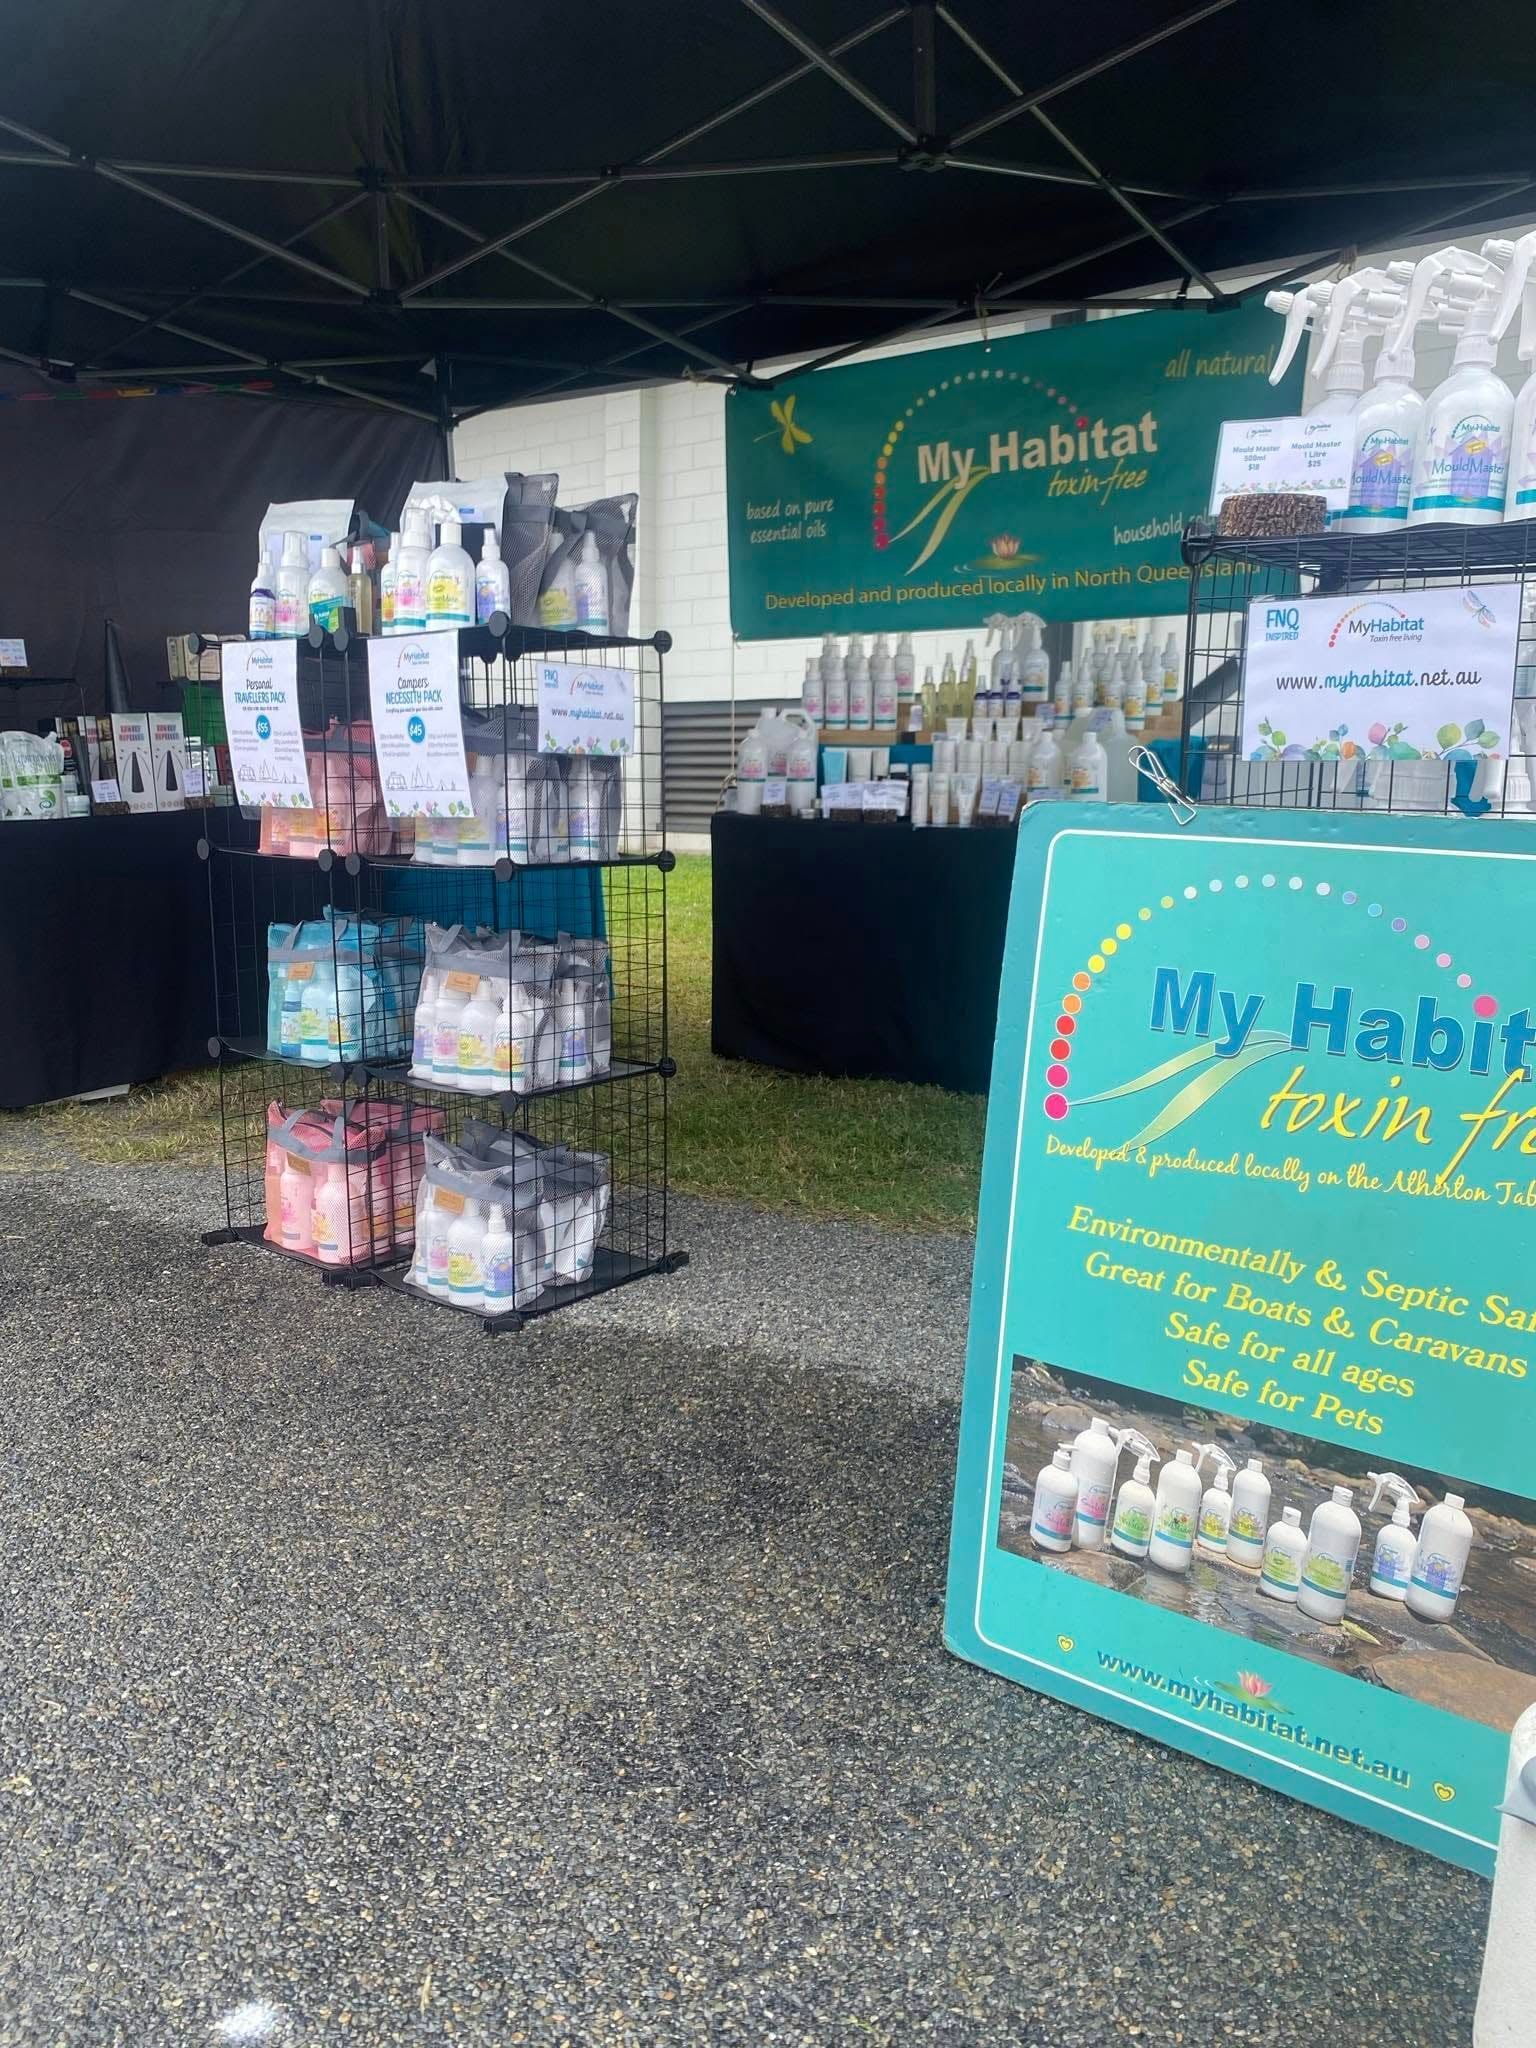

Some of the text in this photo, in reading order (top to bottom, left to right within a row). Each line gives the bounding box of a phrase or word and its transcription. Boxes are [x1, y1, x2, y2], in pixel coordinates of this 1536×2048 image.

[1165, 344, 1275, 378] all natural
[917, 411, 1158, 490] My Habitat
[1307, 460, 1322, 468] $25
[1048, 458, 1148, 506] toxin-free
[746, 499, 834, 521] based on pure
[750, 519, 827, 544] essential oils
[1114, 511, 1183, 546] household
[765, 587, 854, 610] Developed
[858, 586, 892, 604] and
[896, 577, 984, 604] produced
[988, 573, 1047, 596] locally
[1052, 572, 1069, 590] in
[1075, 566, 1132, 587] North
[1266, 608, 1299, 631] FNQ
[1348, 616, 1425, 637] MyHabitat
[1265, 632, 1299, 642] INSPIRED
[1388, 634, 1402, 643] free
[1403, 632, 1423, 643] living
[246, 678, 273, 691] Personal
[398, 677, 430, 692] Campers
[1276, 668, 1482, 694] www.myhabitat.net.au
[234, 691, 287, 704] TRAVELLERS PACK
[424, 690, 443, 703] PACK
[409, 725, 423, 737] $45
[1150, 966, 1536, 1081] My Habit
[1260, 1065, 1433, 1146] toxin
[1046, 1134, 1131, 1171] Developed
[1135, 1146, 1148, 1164] &
[1149, 1148, 1240, 1178] produced
[1244, 1152, 1311, 1193] locally
[1318, 1171, 1342, 1185] on
[1347, 1162, 1382, 1190] the
[1384, 1168, 1492, 1201] Atherton
[1066, 1205, 1306, 1284] Environmentally
[1314, 1258, 1347, 1293] &
[1360, 1268, 1469, 1317] Septic
[1084, 1251, 1528, 1379] Great for Boats & Caravans
[1164, 1312, 1416, 1399] Safe for all ages
[1182, 1360, 1385, 1436] Safe for Pets
[1097, 1650, 1412, 1790] www.myhabitat.net.au
